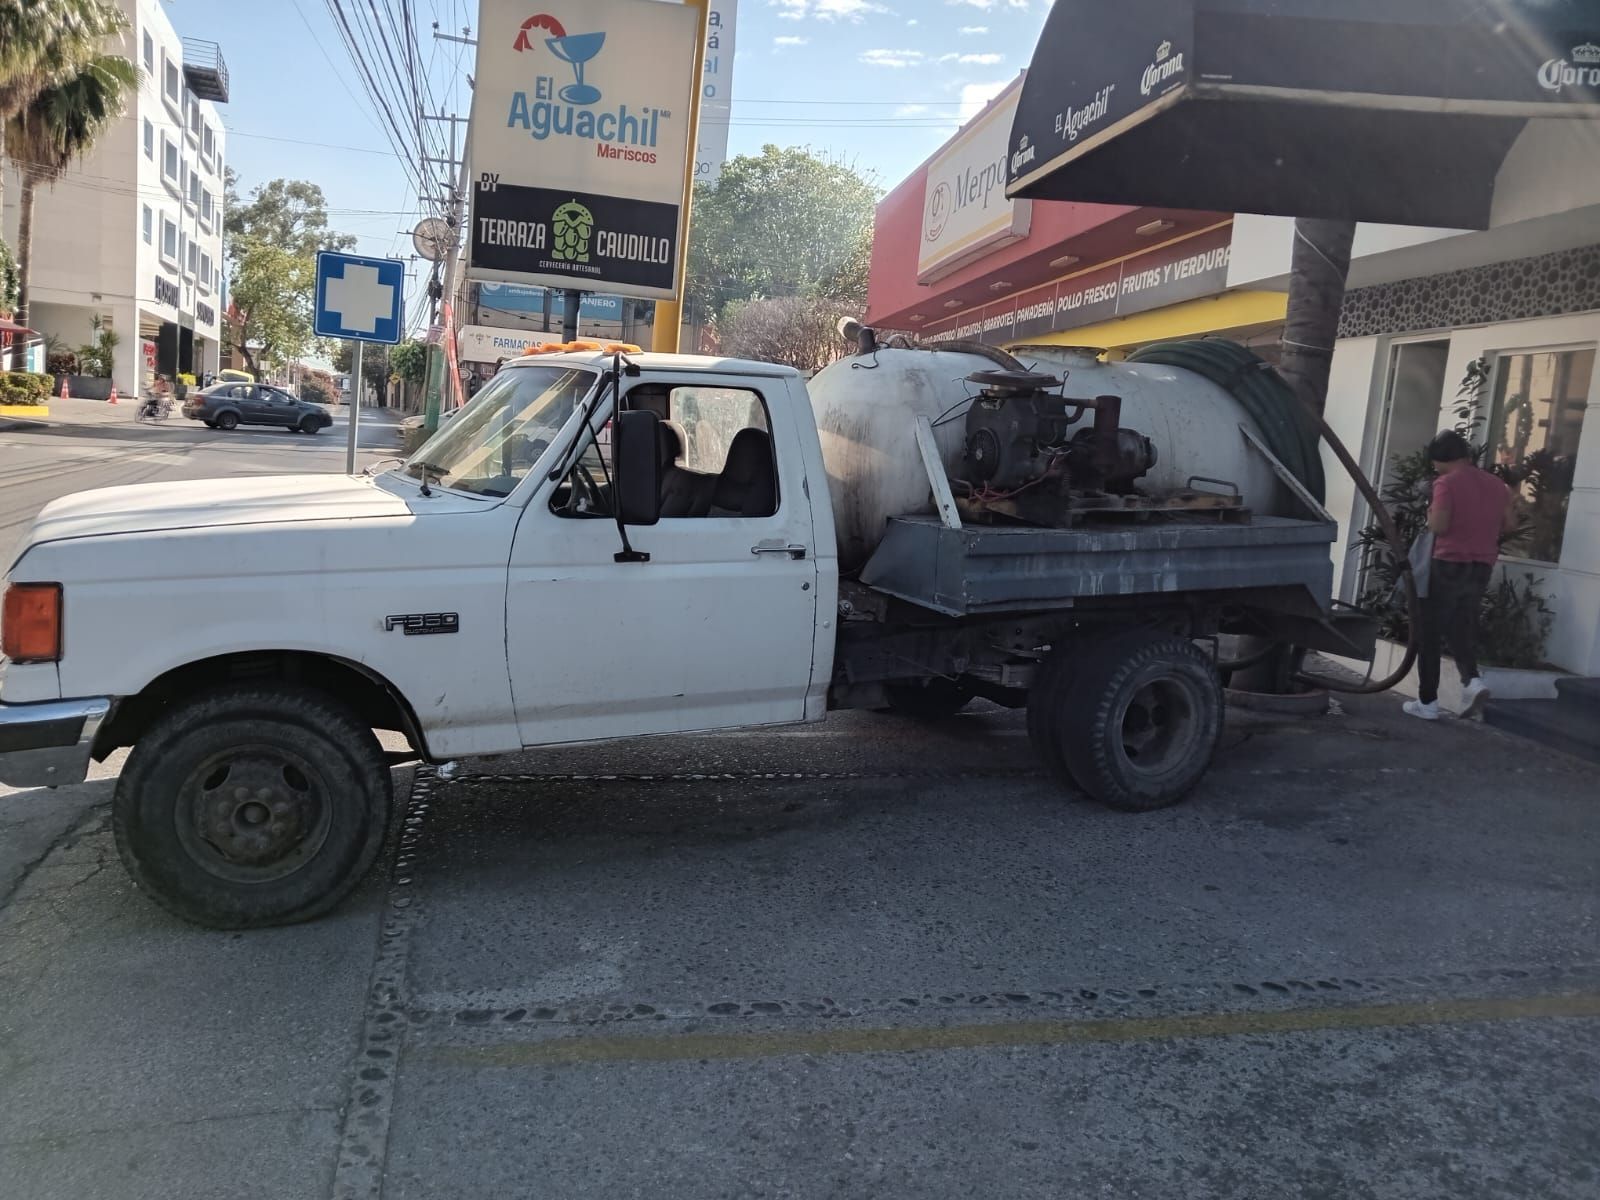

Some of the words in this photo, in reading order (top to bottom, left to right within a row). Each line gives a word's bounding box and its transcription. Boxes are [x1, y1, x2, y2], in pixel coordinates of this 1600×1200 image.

[536, 76, 553, 100] El
[1141, 53, 1183, 95] Corona
[507, 92, 658, 147] Aguachil
[1062, 86, 1109, 141] Aguachil
[597, 144, 657, 163] Mariscos
[1011, 145, 1035, 175] Corona
[480, 172, 500, 193] BY
[480, 217, 546, 249] TERRAZA
[597, 231, 670, 264] CAUDILLO
[1016, 297, 1054, 323] PANADERÍA
[1057, 292, 1081, 312] POLLO
[1083, 281, 1117, 304] FRESCO
[1122, 267, 1161, 295] FRUTAS
[1164, 264, 1172, 283] Y
[493, 337, 542, 351] FARMACIAS
